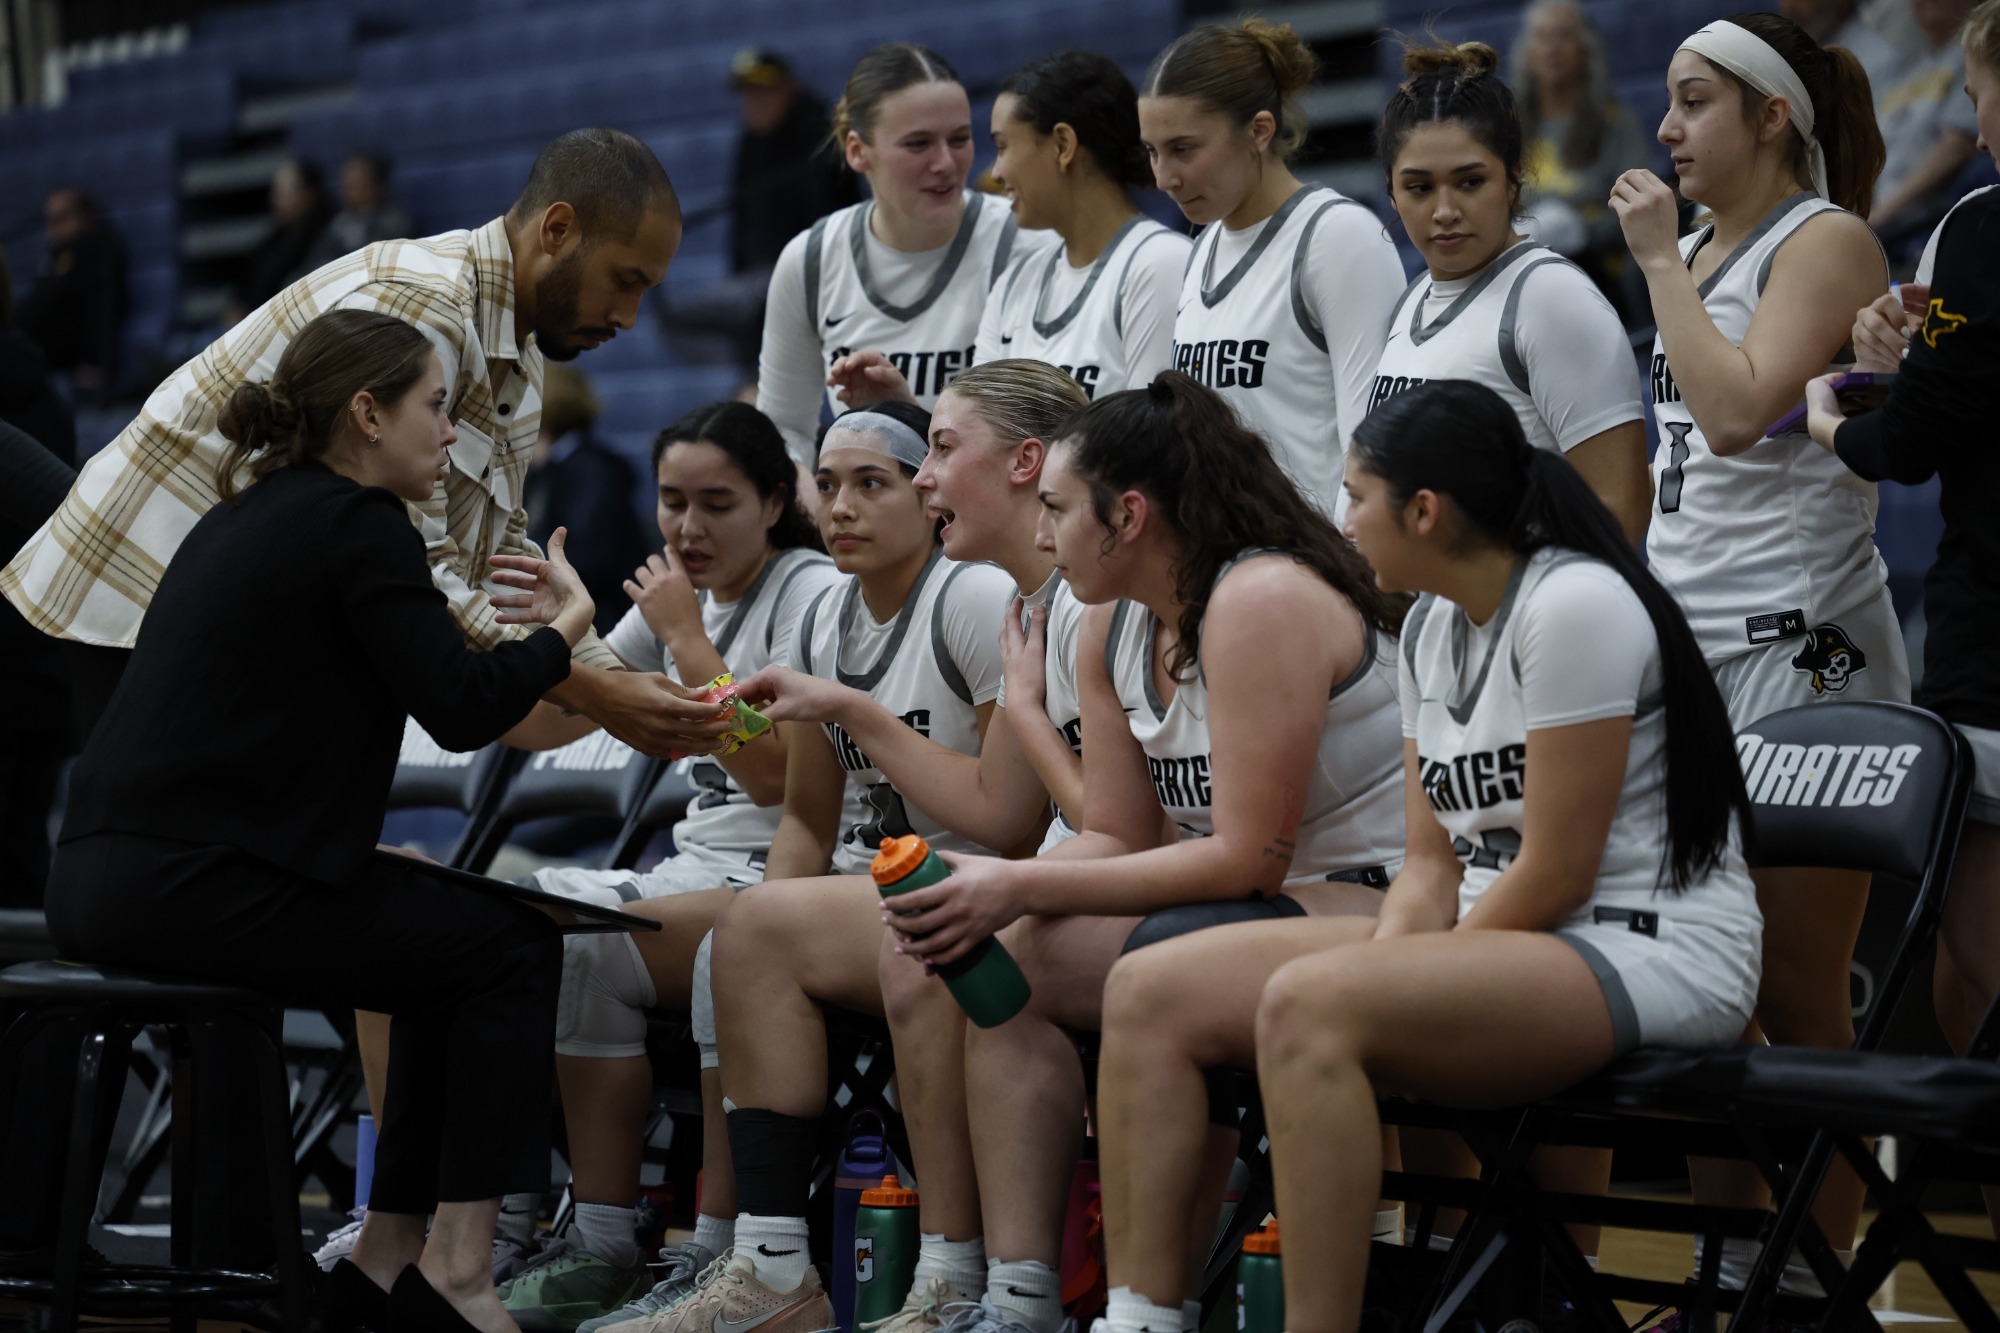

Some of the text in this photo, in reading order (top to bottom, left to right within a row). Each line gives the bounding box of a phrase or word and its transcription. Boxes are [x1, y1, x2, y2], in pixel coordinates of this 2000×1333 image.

[1171, 340, 1270, 389] IRATES
[1659, 421, 1693, 514] 1
[1785, 619, 1797, 630] M
[1149, 753, 1211, 807] RATE
[1419, 744, 1526, 811] RATES
[1367, 871, 1378, 883] L
[1637, 914, 1648, 929] L
